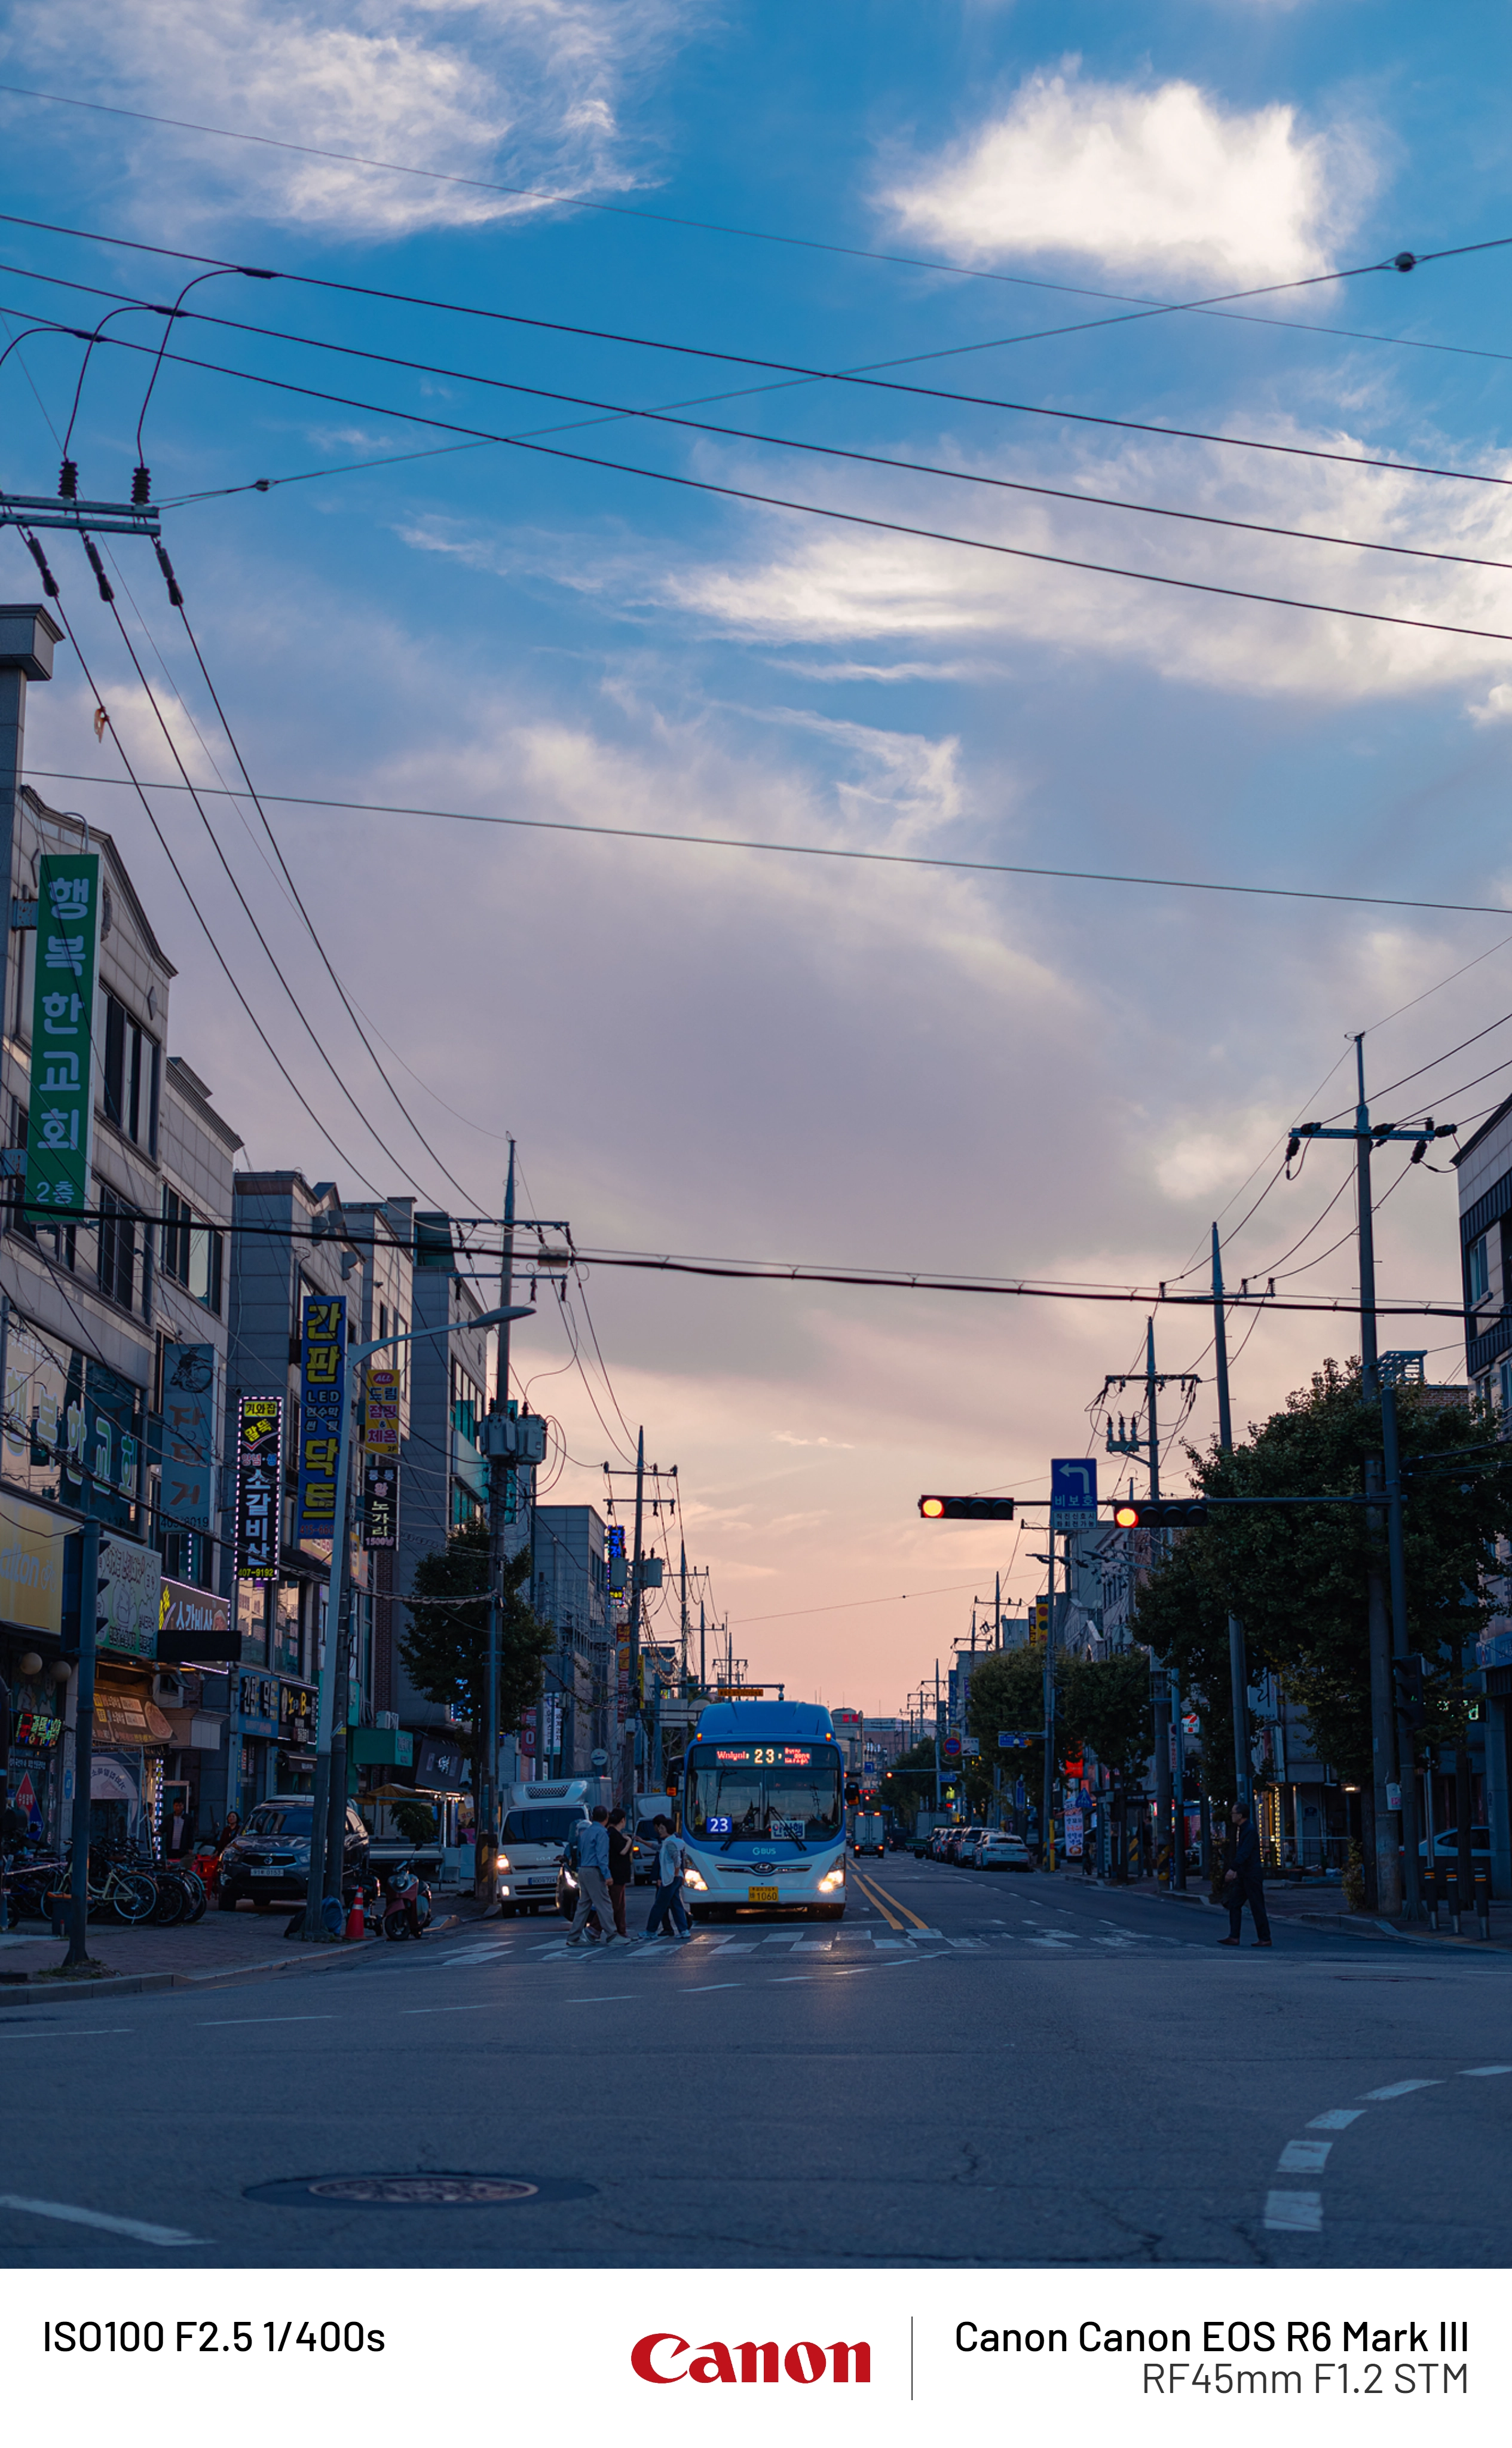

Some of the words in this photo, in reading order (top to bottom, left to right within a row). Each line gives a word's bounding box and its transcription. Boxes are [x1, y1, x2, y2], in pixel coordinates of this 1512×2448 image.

[37, 877, 90, 1150] 행복한교회
[36, 1181, 75, 1204] 2층
[306, 1302, 341, 1384] 간판
[307, 1391, 339, 1403] LED
[369, 1387, 398, 1401] 드림
[302, 1437, 339, 1519] 닥트
[1054, 1494, 1094, 1507] 비보호
[244, 1468, 271, 1566] 소갈비살
[372, 1500, 390, 1537] 노가리
[0, 1542, 40, 1589] alton
[238, 1568, 274, 1577] 407-9192
[754, 1748, 775, 1764] 23
[709, 1817, 729, 1833] 23
[757, 1892, 777, 1901] 1060
